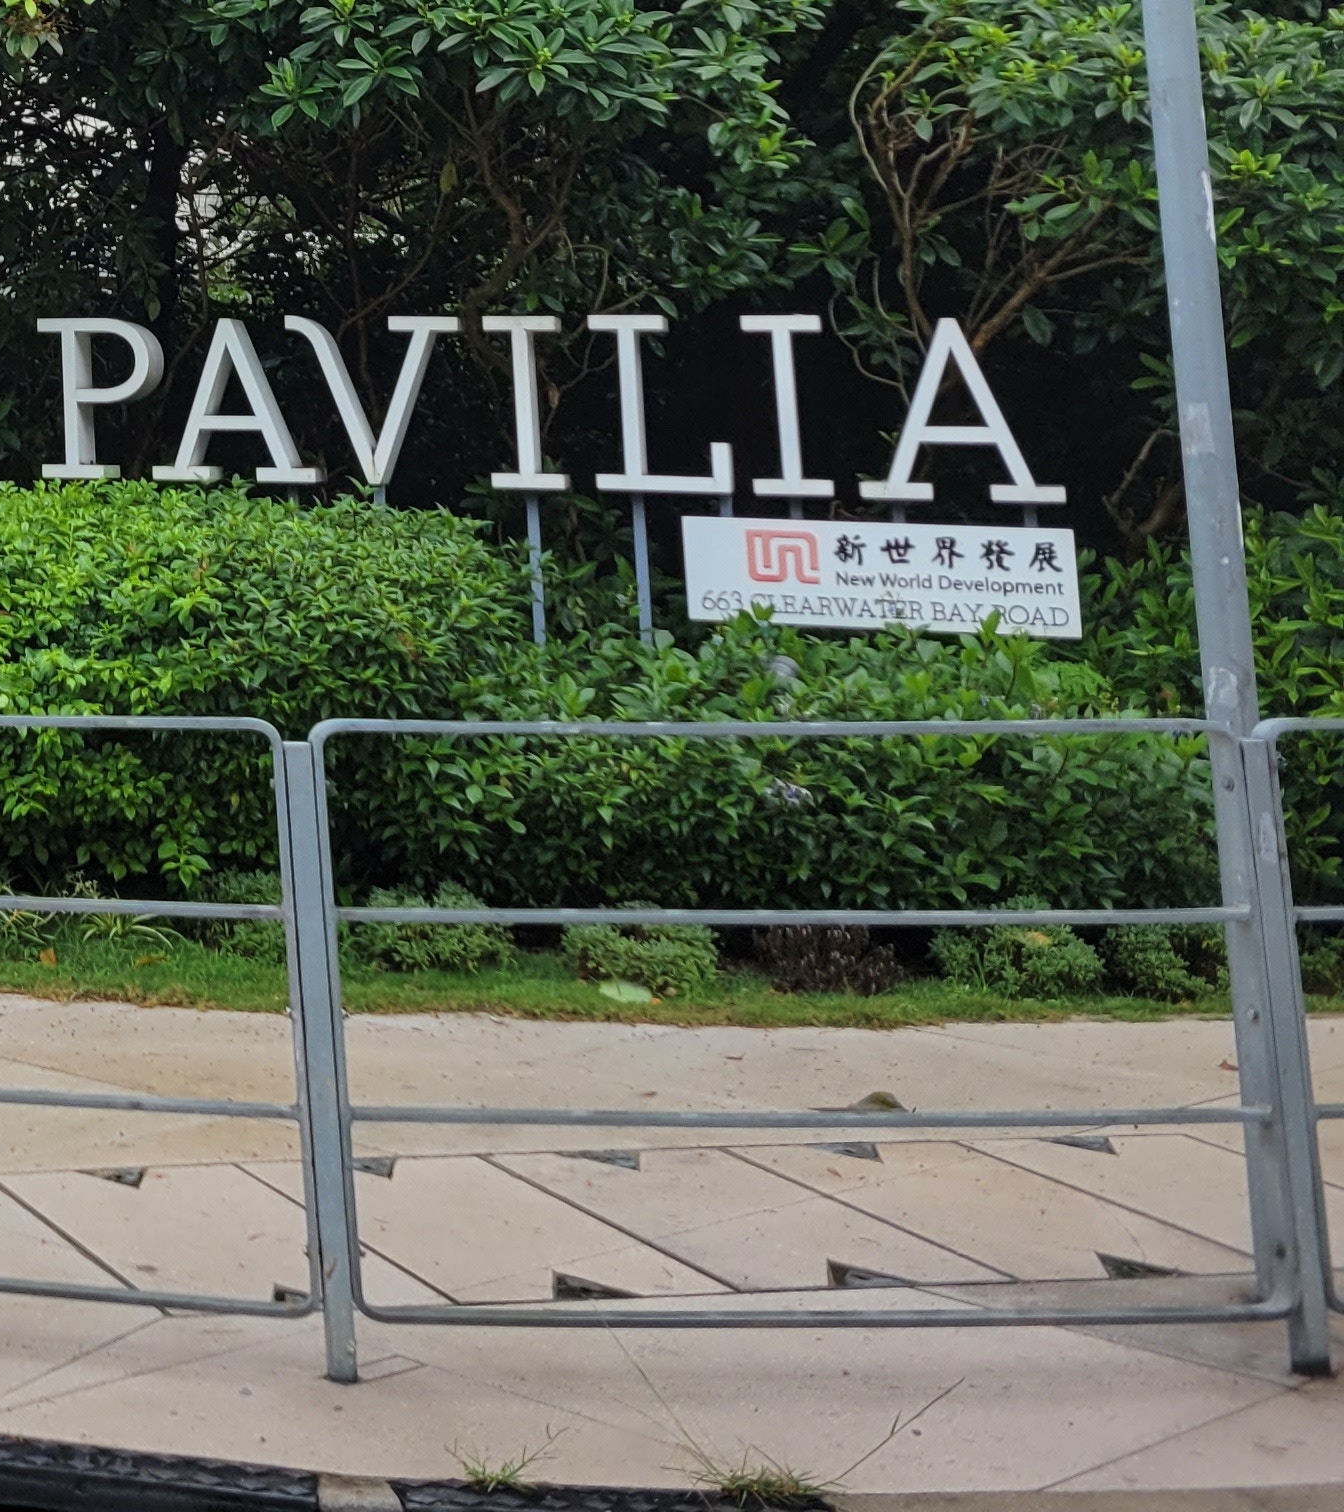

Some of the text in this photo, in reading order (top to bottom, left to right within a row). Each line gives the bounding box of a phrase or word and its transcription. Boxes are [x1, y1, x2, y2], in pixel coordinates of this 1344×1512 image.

[36, 314, 1066, 505] PAVILIA
[834, 534, 1063, 573] 新世界發展
[836, 571, 1064, 596] New World Development
[702, 590, 743, 611] 663
[930, 601, 983, 623] BAY
[991, 604, 1070, 626] ROAD
